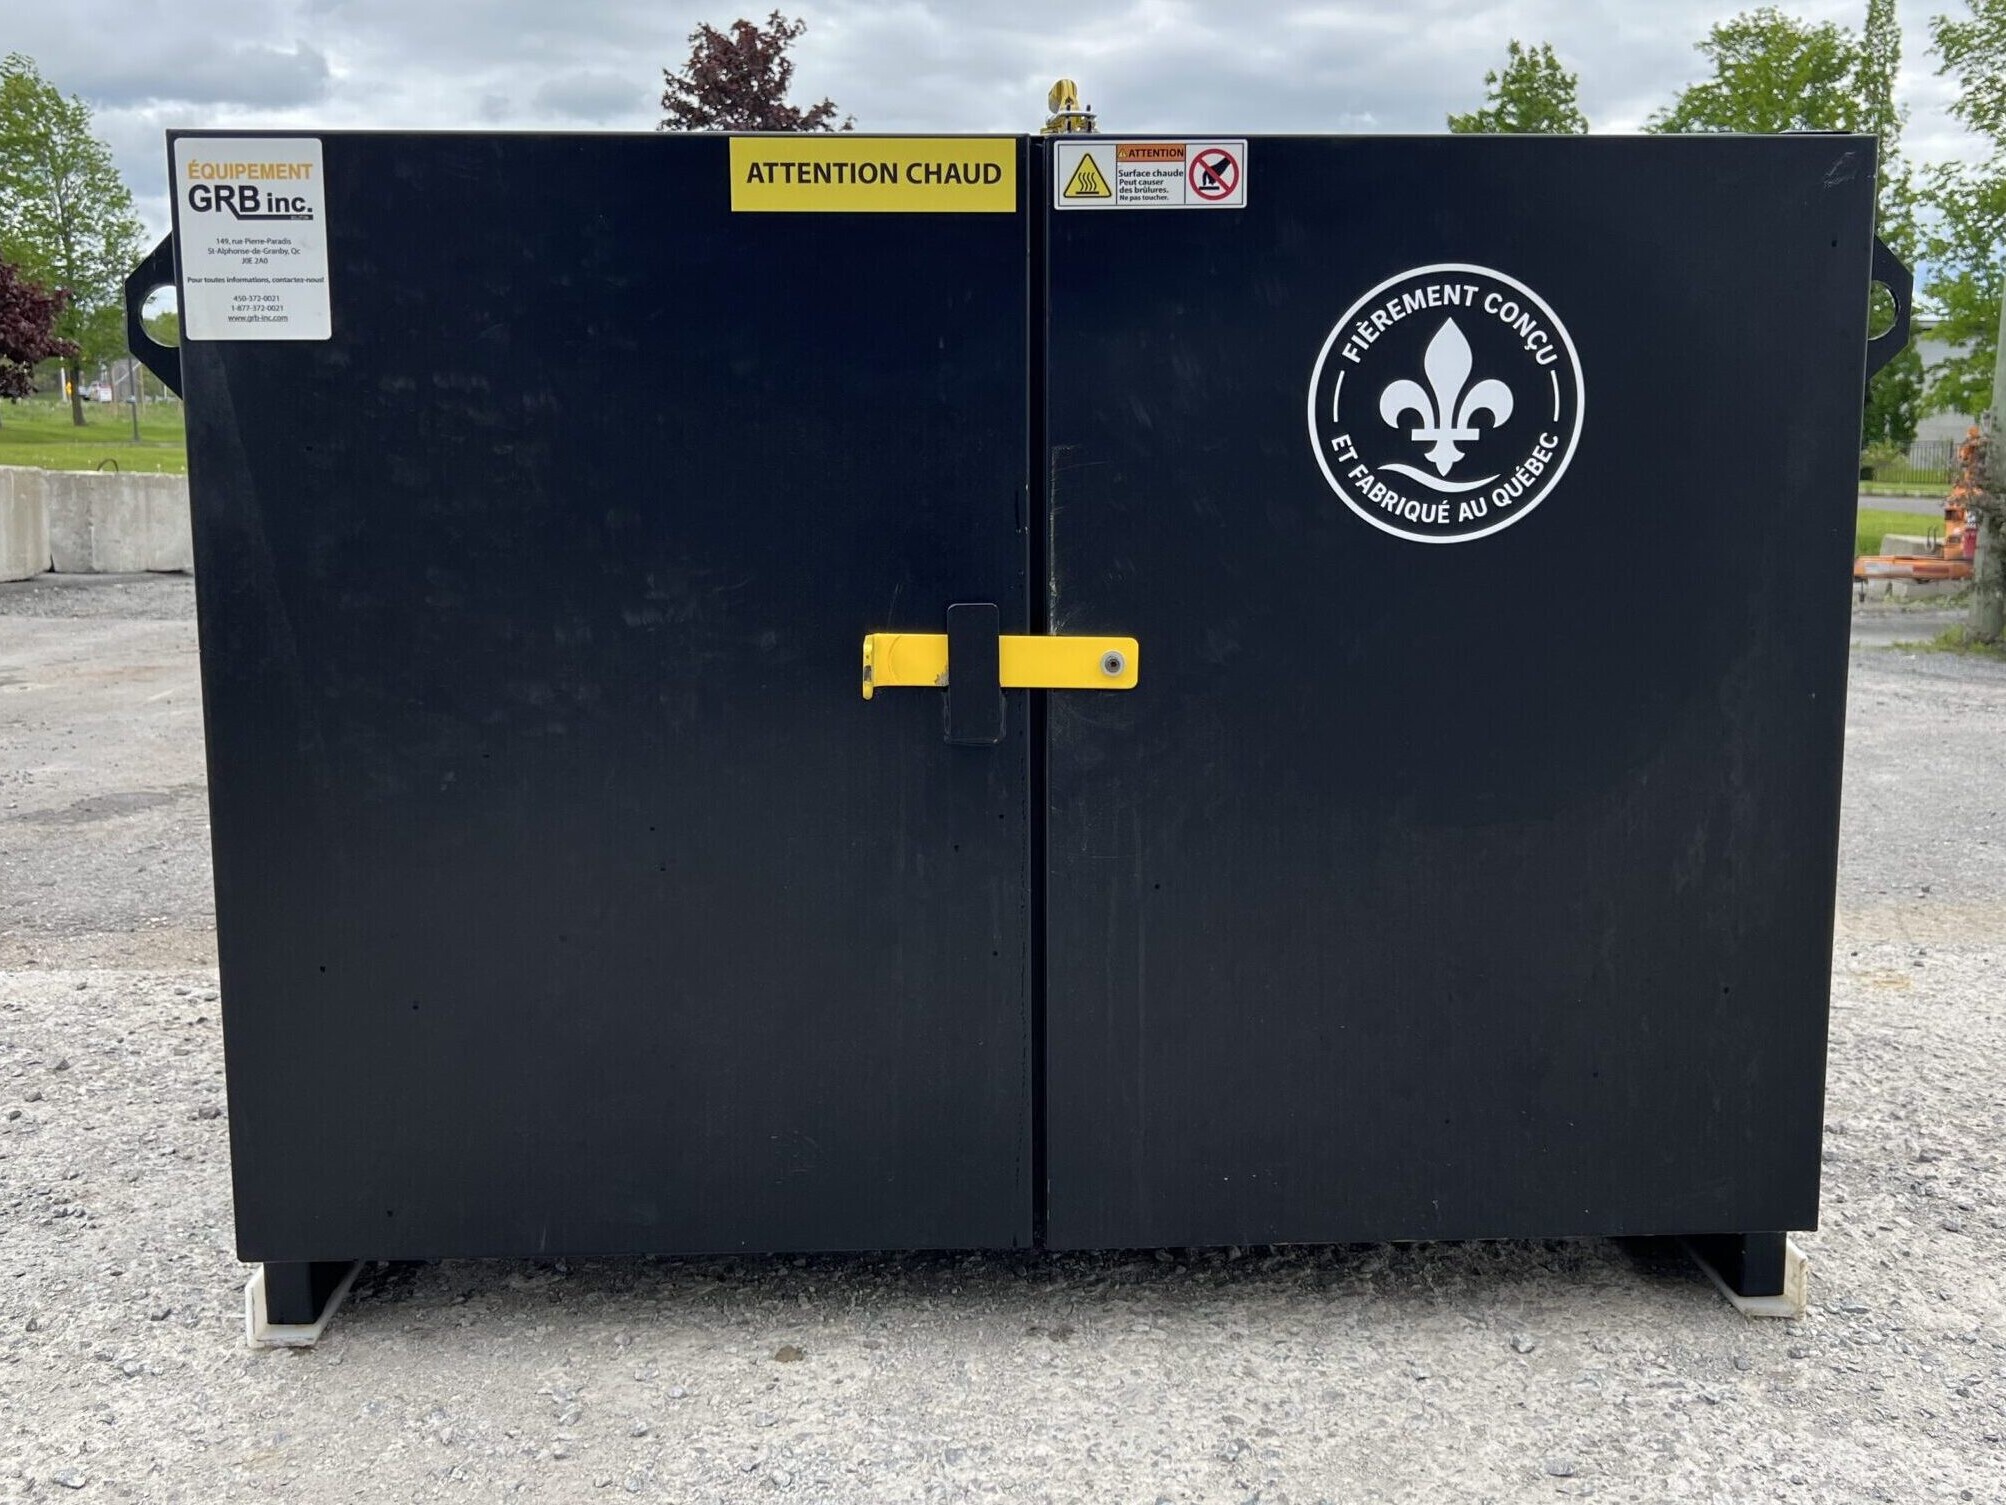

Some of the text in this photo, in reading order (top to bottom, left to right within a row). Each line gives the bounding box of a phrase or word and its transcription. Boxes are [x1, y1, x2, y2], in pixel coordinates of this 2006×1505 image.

[1128, 148, 1184, 158] ATTENTION
[188, 160, 313, 180] ÉQUIPEMENT
[746, 162, 1002, 185] ATTENTION CHAUD
[1118, 169, 1184, 178] Surface chaude
[1119, 186, 1169, 194] des brûlures.
[188, 184, 313, 213] GRB inc.
[216, 238, 231, 246] 149,
[228, 314, 289, 322] www.grb-inc.com
[1342, 284, 1558, 366] FIÈREMENT CONÇU
[1331, 432, 1559, 524] ET FABRIQUÉ AU QUÉBEC
